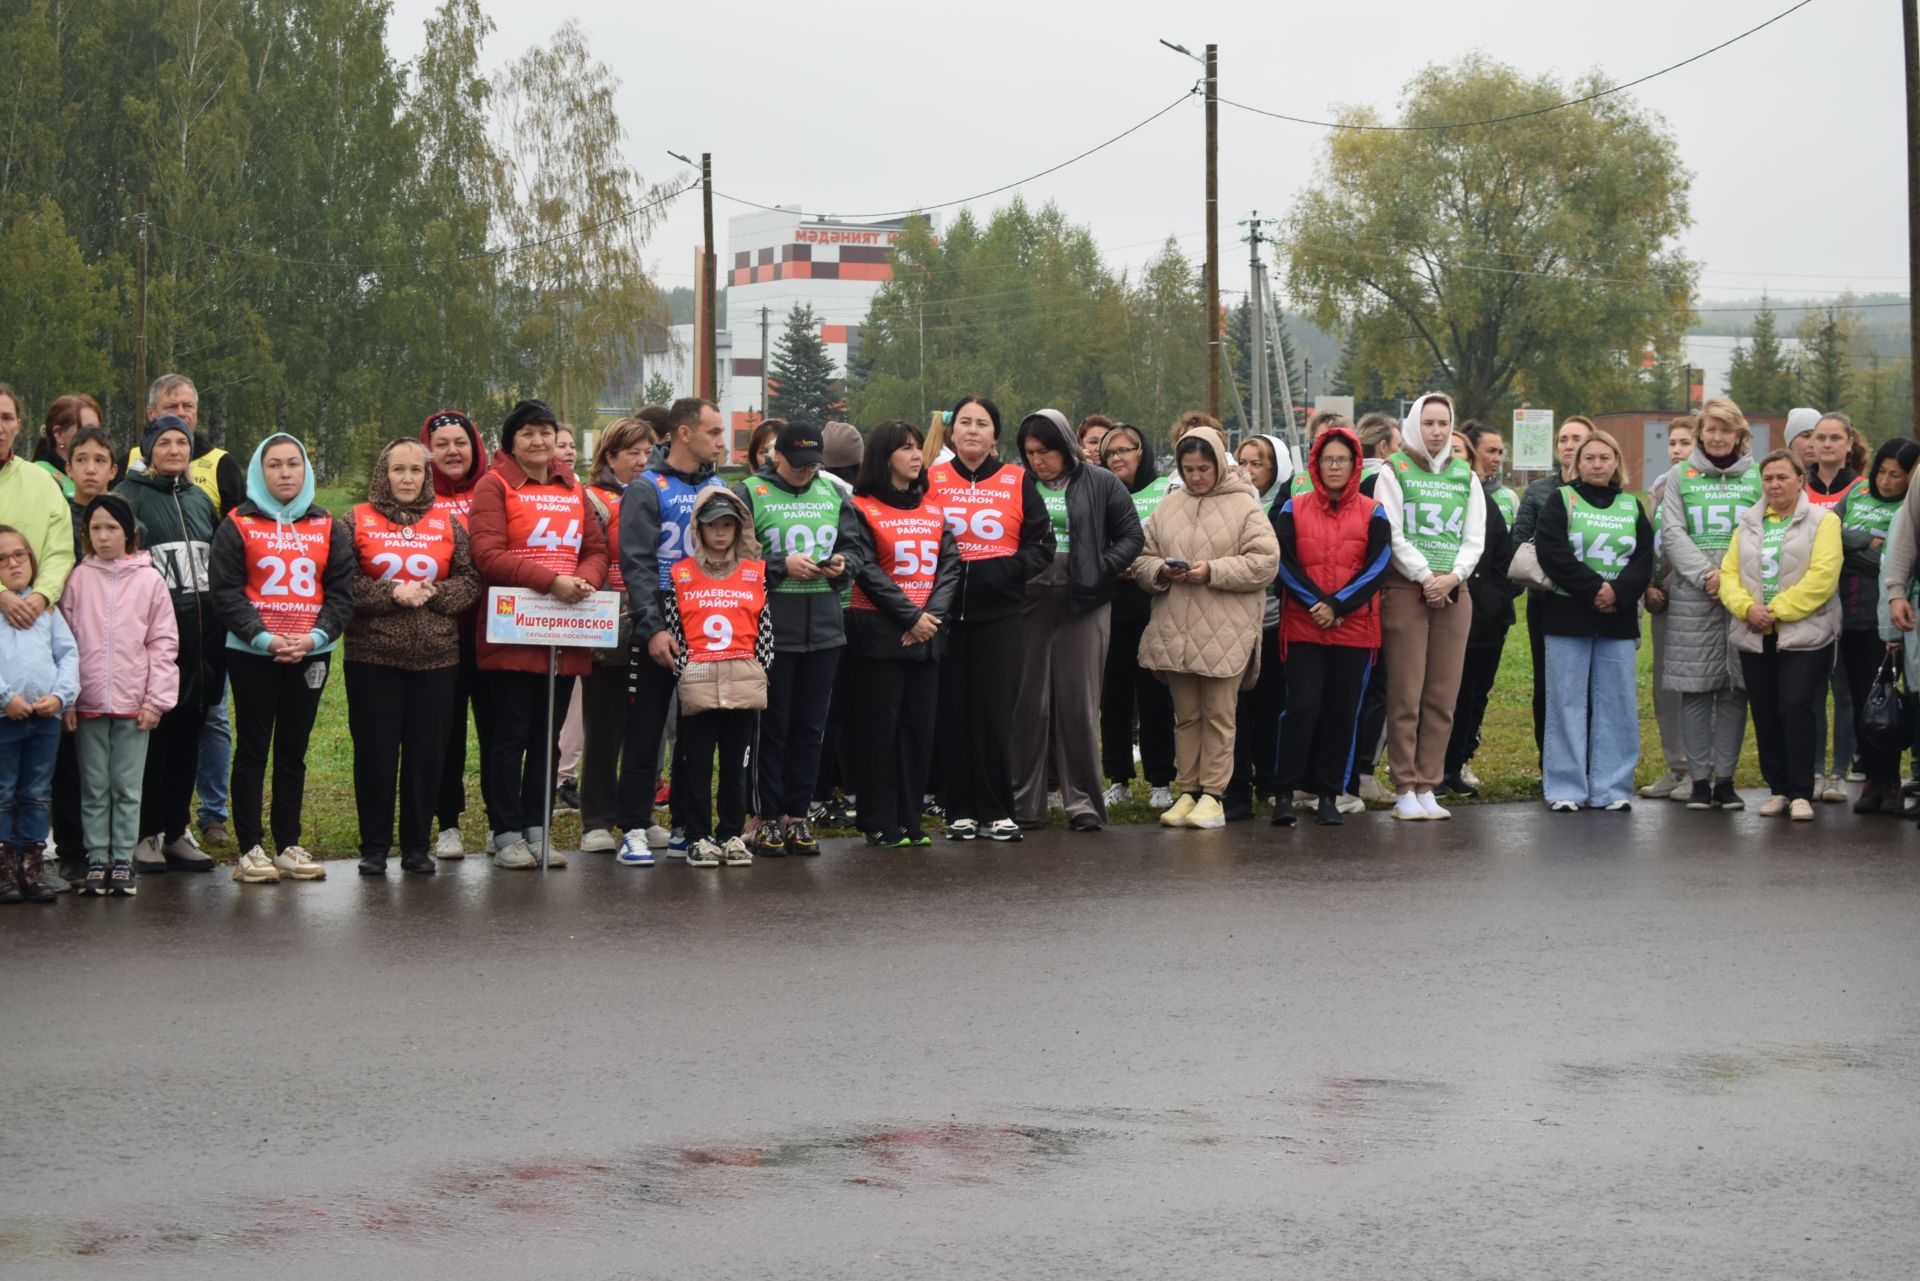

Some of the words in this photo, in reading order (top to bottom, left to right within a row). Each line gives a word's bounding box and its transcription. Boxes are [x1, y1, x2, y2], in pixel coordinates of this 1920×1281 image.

[1405, 480, 1465, 492] ТУКАЕВСКИЙ
[519, 494, 580, 504] ТУКАЕВСКИЙ
[937, 488, 1010, 500] ТУКАЕВСКИЙ
[952, 494, 993, 505] РАЙОН
[1420, 489, 1453, 499] РАЙОН
[1705, 489, 1740, 499] РАЙОН
[536, 502, 571, 513] РАЙОН
[765, 502, 834, 512] ТУКАЕВСКИЙ
[783, 509, 821, 519] РАЙОН
[1572, 512, 1635, 523] ТУКАЕВСКИЙ
[879, 518, 942, 529] ТУКАЕВСКИЙ
[943, 507, 1004, 540] 56
[1403, 502, 1463, 538] 134
[1586, 519, 1623, 529] РАЙОН
[527, 517, 583, 553] 44
[896, 525, 931, 535] РАЙОН
[248, 530, 324, 544] ТУКАЕВКИЙ
[368, 531, 443, 542] ТУКАЕСКИЙ
[764, 524, 837, 560] 109
[384, 538, 428, 549] РАЙОН
[1568, 532, 1636, 566] 142
[893, 540, 938, 576] 55
[371, 553, 438, 585] 29
[256, 556, 316, 597] 28
[683, 588, 753, 600] ТУКАЕВСКИЙ
[699, 597, 738, 608] РАЙОН
[515, 613, 613, 630] Иштеряковское
[563, 632, 602, 640] поселение
[703, 614, 733, 651] 9
